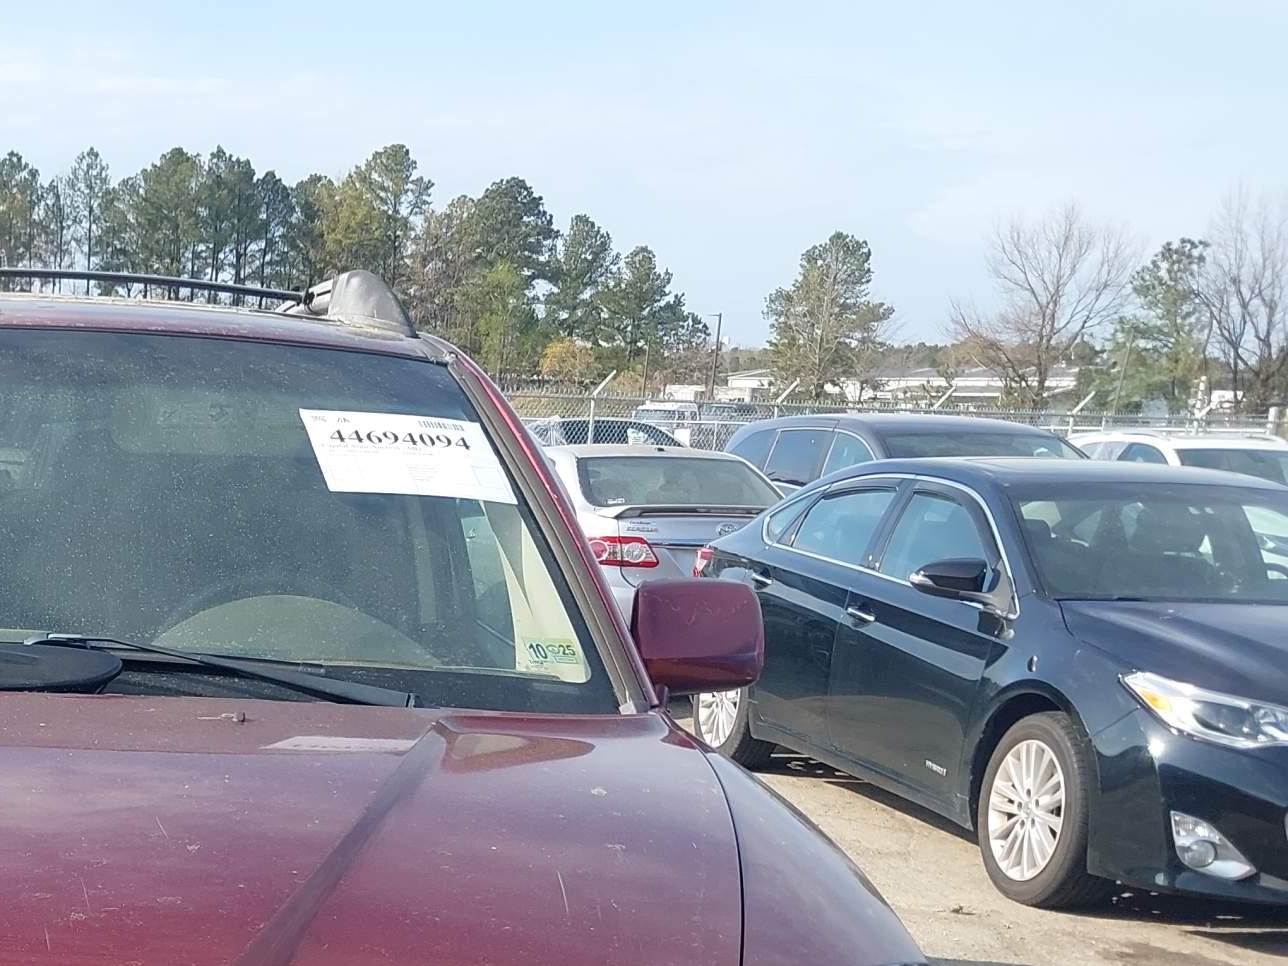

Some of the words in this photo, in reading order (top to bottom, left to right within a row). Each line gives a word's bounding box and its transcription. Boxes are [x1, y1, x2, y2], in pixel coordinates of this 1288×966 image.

[329, 428, 472, 451] 44694094
[529, 643, 548, 660] 10
[559, 645, 576, 656] 25
